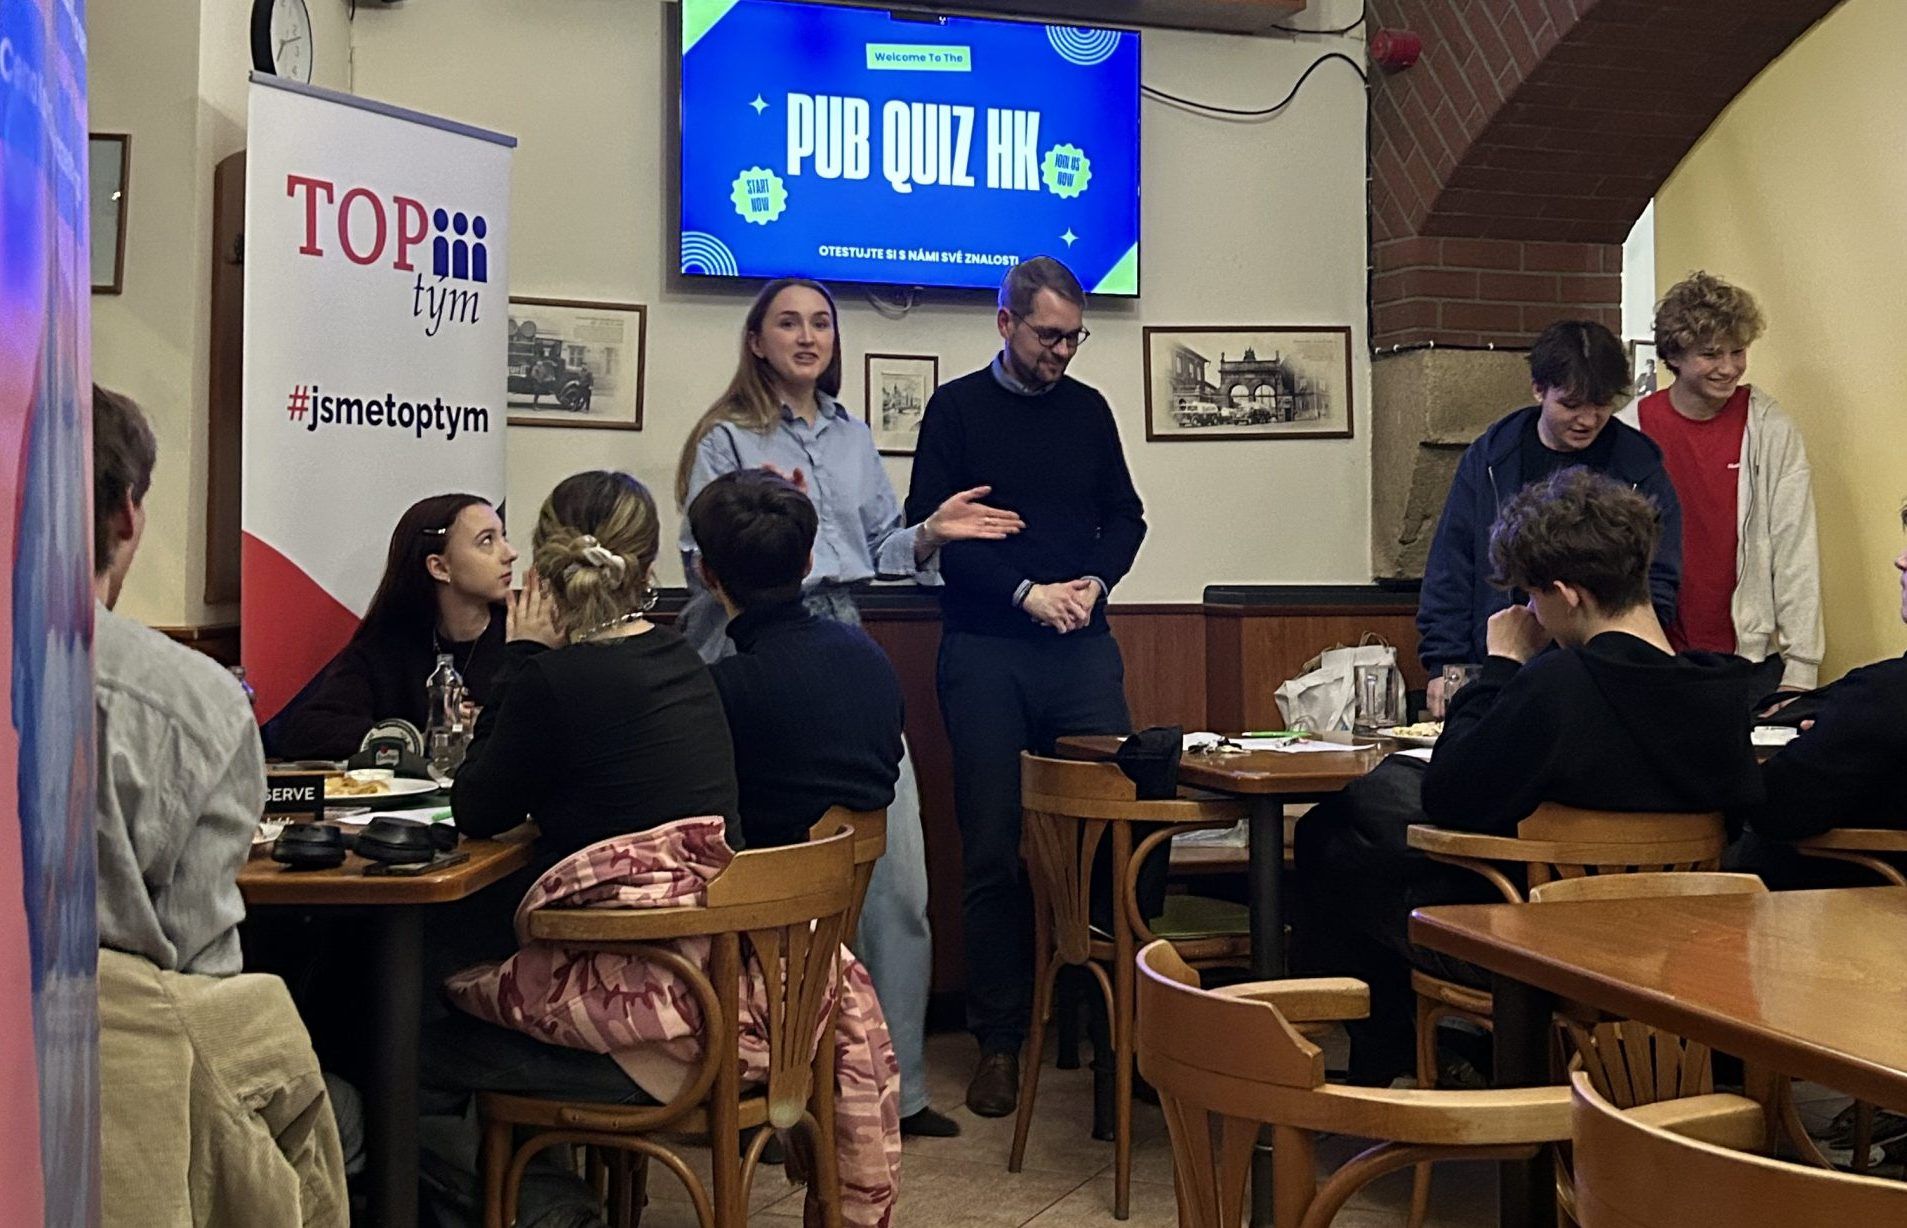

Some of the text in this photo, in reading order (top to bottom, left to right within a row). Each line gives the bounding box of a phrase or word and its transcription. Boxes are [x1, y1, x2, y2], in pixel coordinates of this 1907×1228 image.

[875, 51, 963, 63] Welcome To The
[787, 92, 1041, 194] PUB QUIZ HK
[1070, 156, 1080, 171] US
[746, 178, 769, 194] START
[1057, 171, 1075, 187] NOW
[751, 197, 769, 212] NOW
[287, 174, 429, 272] TOP
[818, 244, 1019, 266] OTESTUJTE SI S NÁMI SVÉ ZNALOSTI
[413, 273, 480, 337] tým
[287, 384, 488, 440] #jsmetoptym
